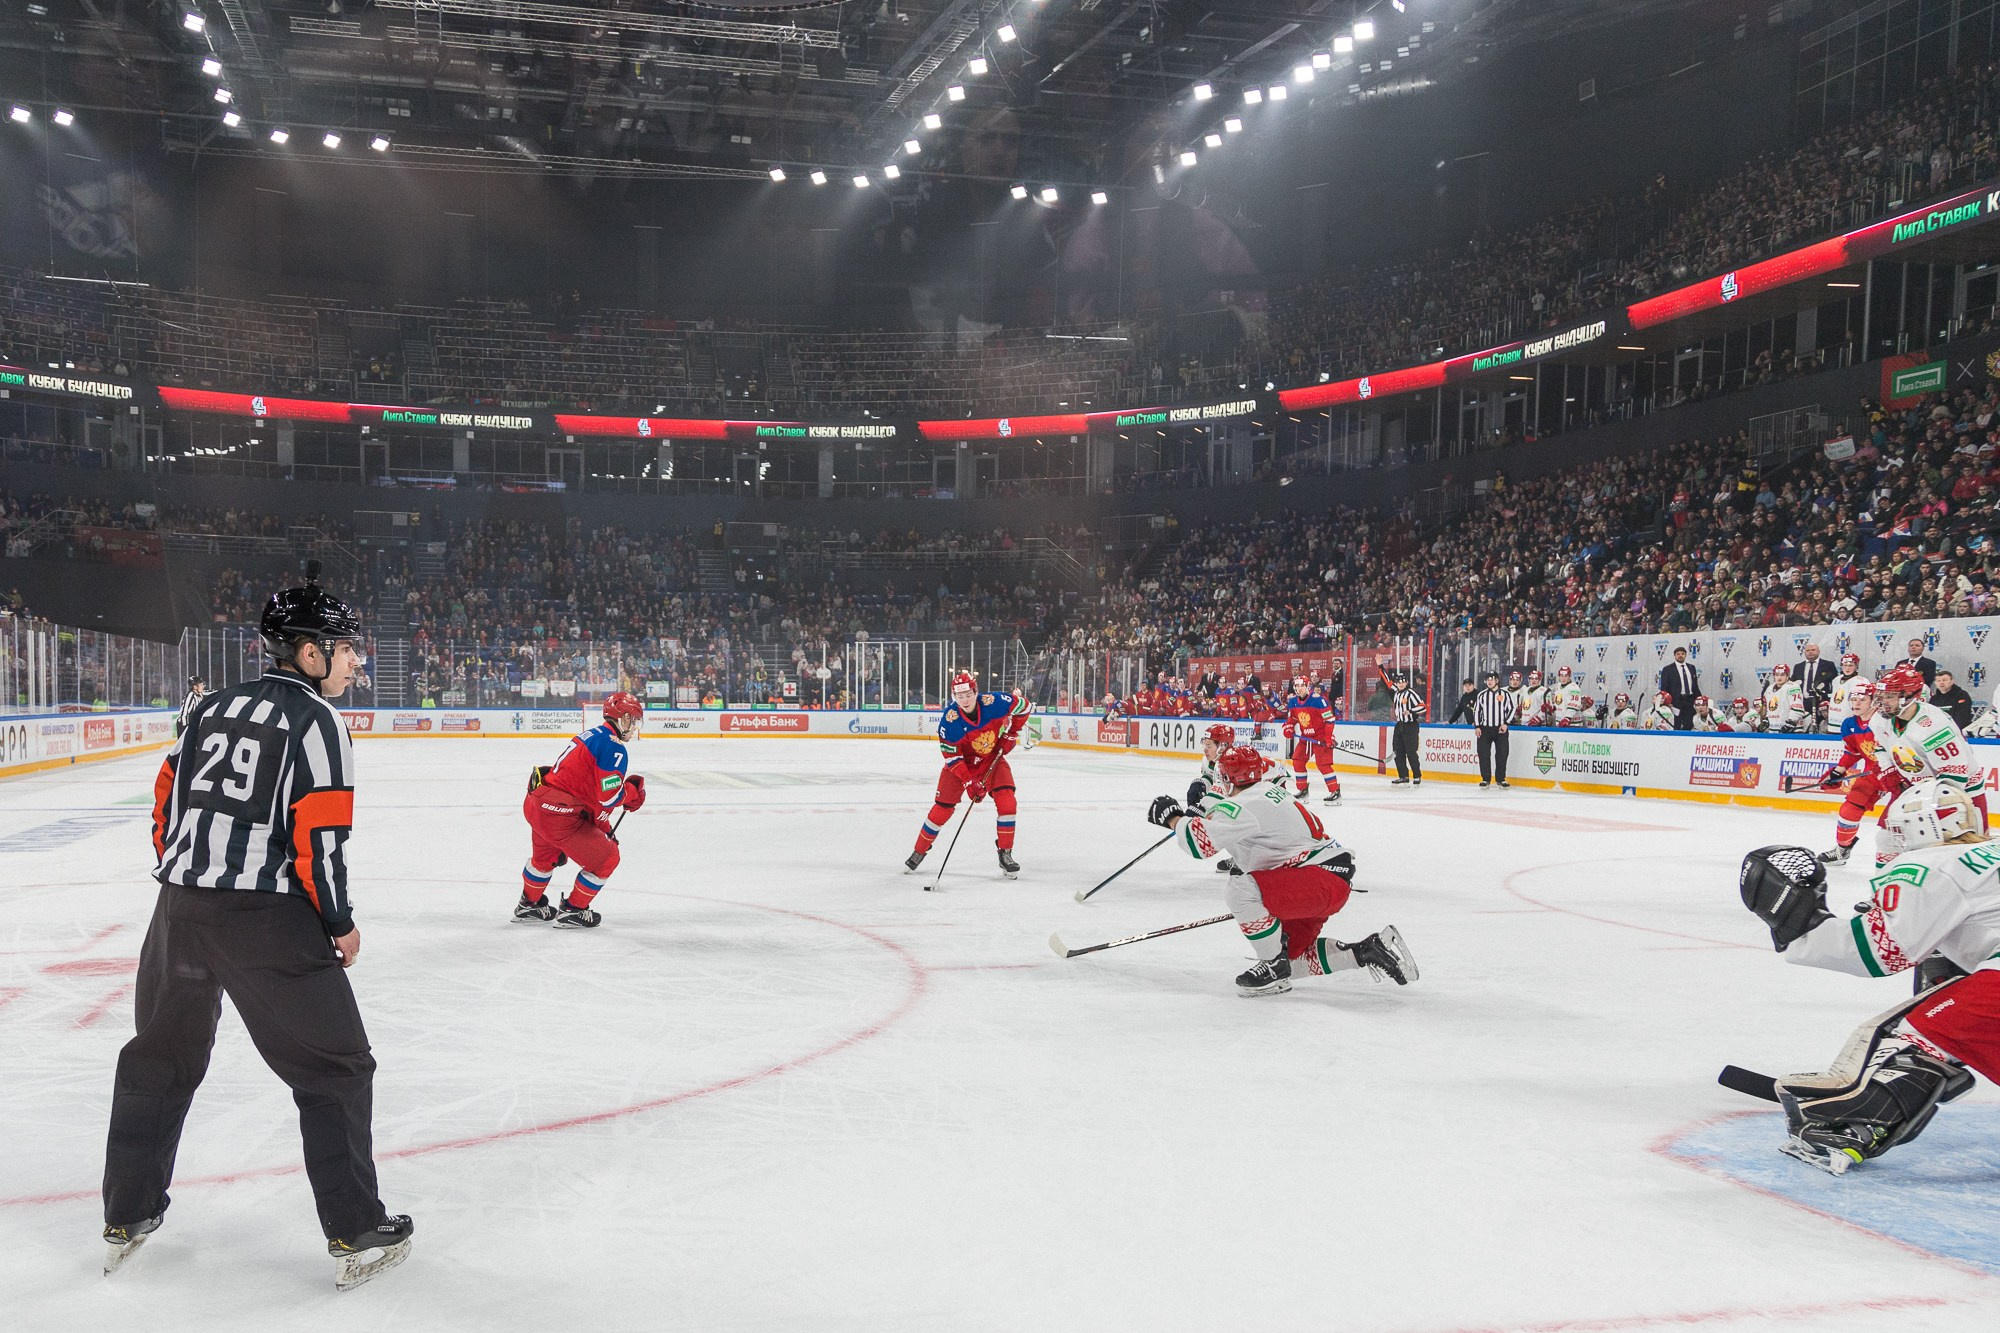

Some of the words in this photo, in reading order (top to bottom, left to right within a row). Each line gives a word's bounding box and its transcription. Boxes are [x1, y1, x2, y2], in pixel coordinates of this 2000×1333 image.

[1892, 219, 1926, 243] Лига
[1927, 200, 1981, 232] Ставок
[1472, 358, 1491, 372] Лига
[1492, 349, 1522, 367] Ставок
[1524, 338, 1553, 359] КУБОК
[28, 374, 65, 391] КУБОК
[382, 410, 404, 422] Лига
[405, 411, 436, 424] Ставок
[440, 413, 473, 426] КУБОК
[1116, 415, 1135, 427] Лига
[1136, 413, 1167, 425] Ставок
[1170, 407, 1201, 422] КУБОК
[756, 425, 776, 437] Лига
[776, 426, 806, 437] Ставок
[809, 426, 840, 438] КУБОК
[730, 716, 768, 730] Альфа
[769, 716, 798, 727] Банк
[860, 726, 888, 734] ГАЗПРОМ
[1100, 732, 1127, 742] СПОРТ
[1151, 722, 1196, 750] АУРА
[1340, 740, 1365, 749] АРЕНА
[1425, 739, 1472, 751] ФЕДЕРАЦИЯ
[1563, 741, 1580, 754] Лига
[1582, 741, 1611, 756] Ставок
[1695, 744, 1734, 756] КРАСНАЯ
[1934, 741, 1960, 761] 98
[614, 752, 624, 768] 7
[1425, 752, 1456, 763] ХОККЕЯ
[1785, 747, 1829, 760] КРАСНАЯ
[190, 732, 261, 802] 29
[1562, 759, 1589, 773] КУБОК
[1592, 760, 1640, 776] БУДУЩЕГО
[1692, 757, 1734, 773] МАШИНА
[541, 803, 574, 813] BAUER
[1925, 998, 1955, 1018] Reebok
